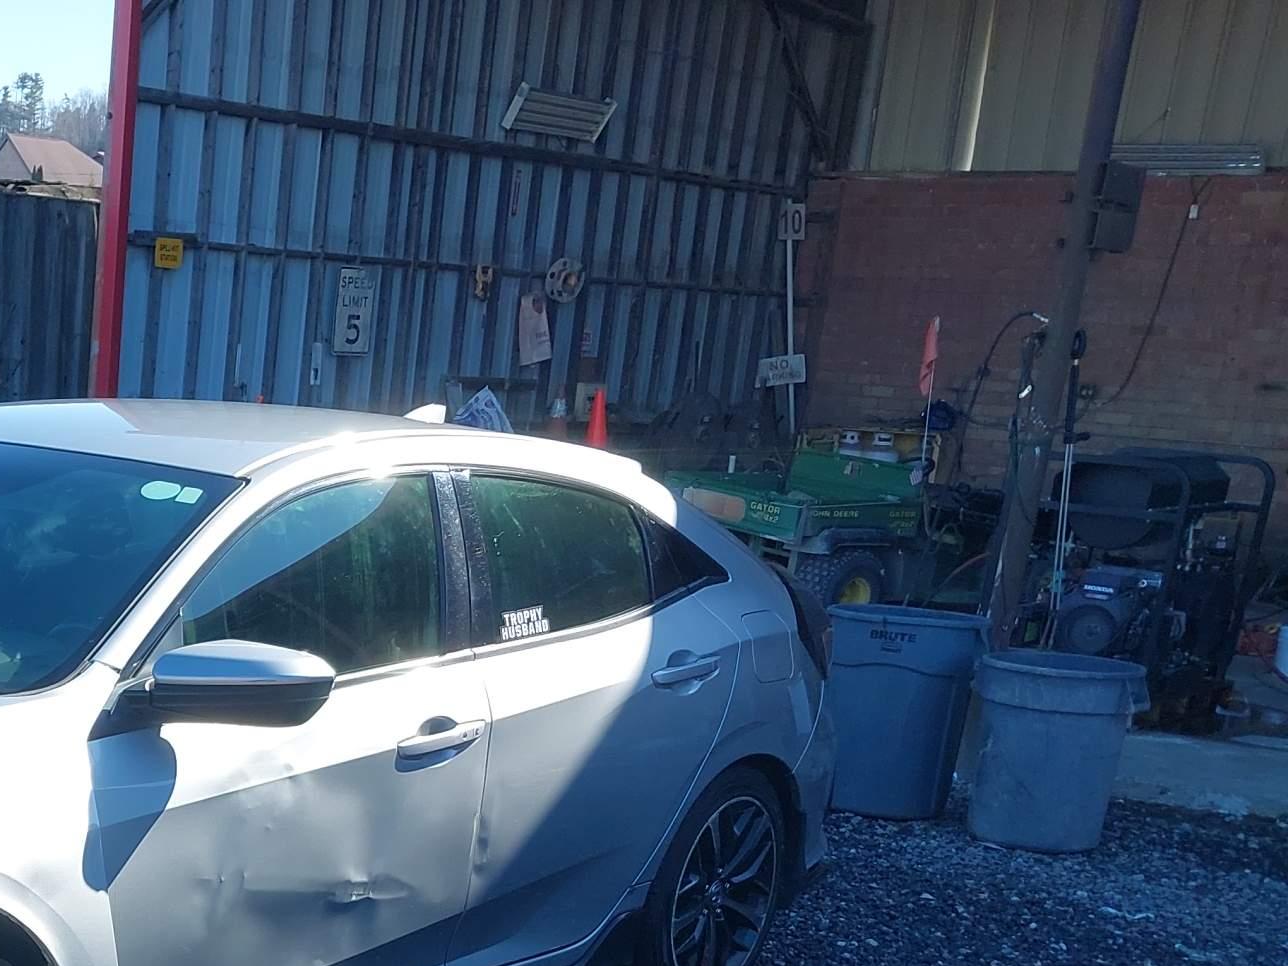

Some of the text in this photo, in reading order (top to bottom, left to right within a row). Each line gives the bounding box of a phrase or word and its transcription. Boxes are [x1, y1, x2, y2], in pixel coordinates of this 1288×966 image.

[781, 209, 802, 234] 10
[341, 276, 375, 289] SPEED
[342, 295, 368, 308] LIMIT
[344, 314, 361, 345] 5
[750, 501, 780, 515] GATOR
[812, 510, 831, 518] OHN
[503, 607, 543, 627] TROPHY
[501, 619, 550, 641] HUSBAND
[870, 629, 917, 643] BRUTE
